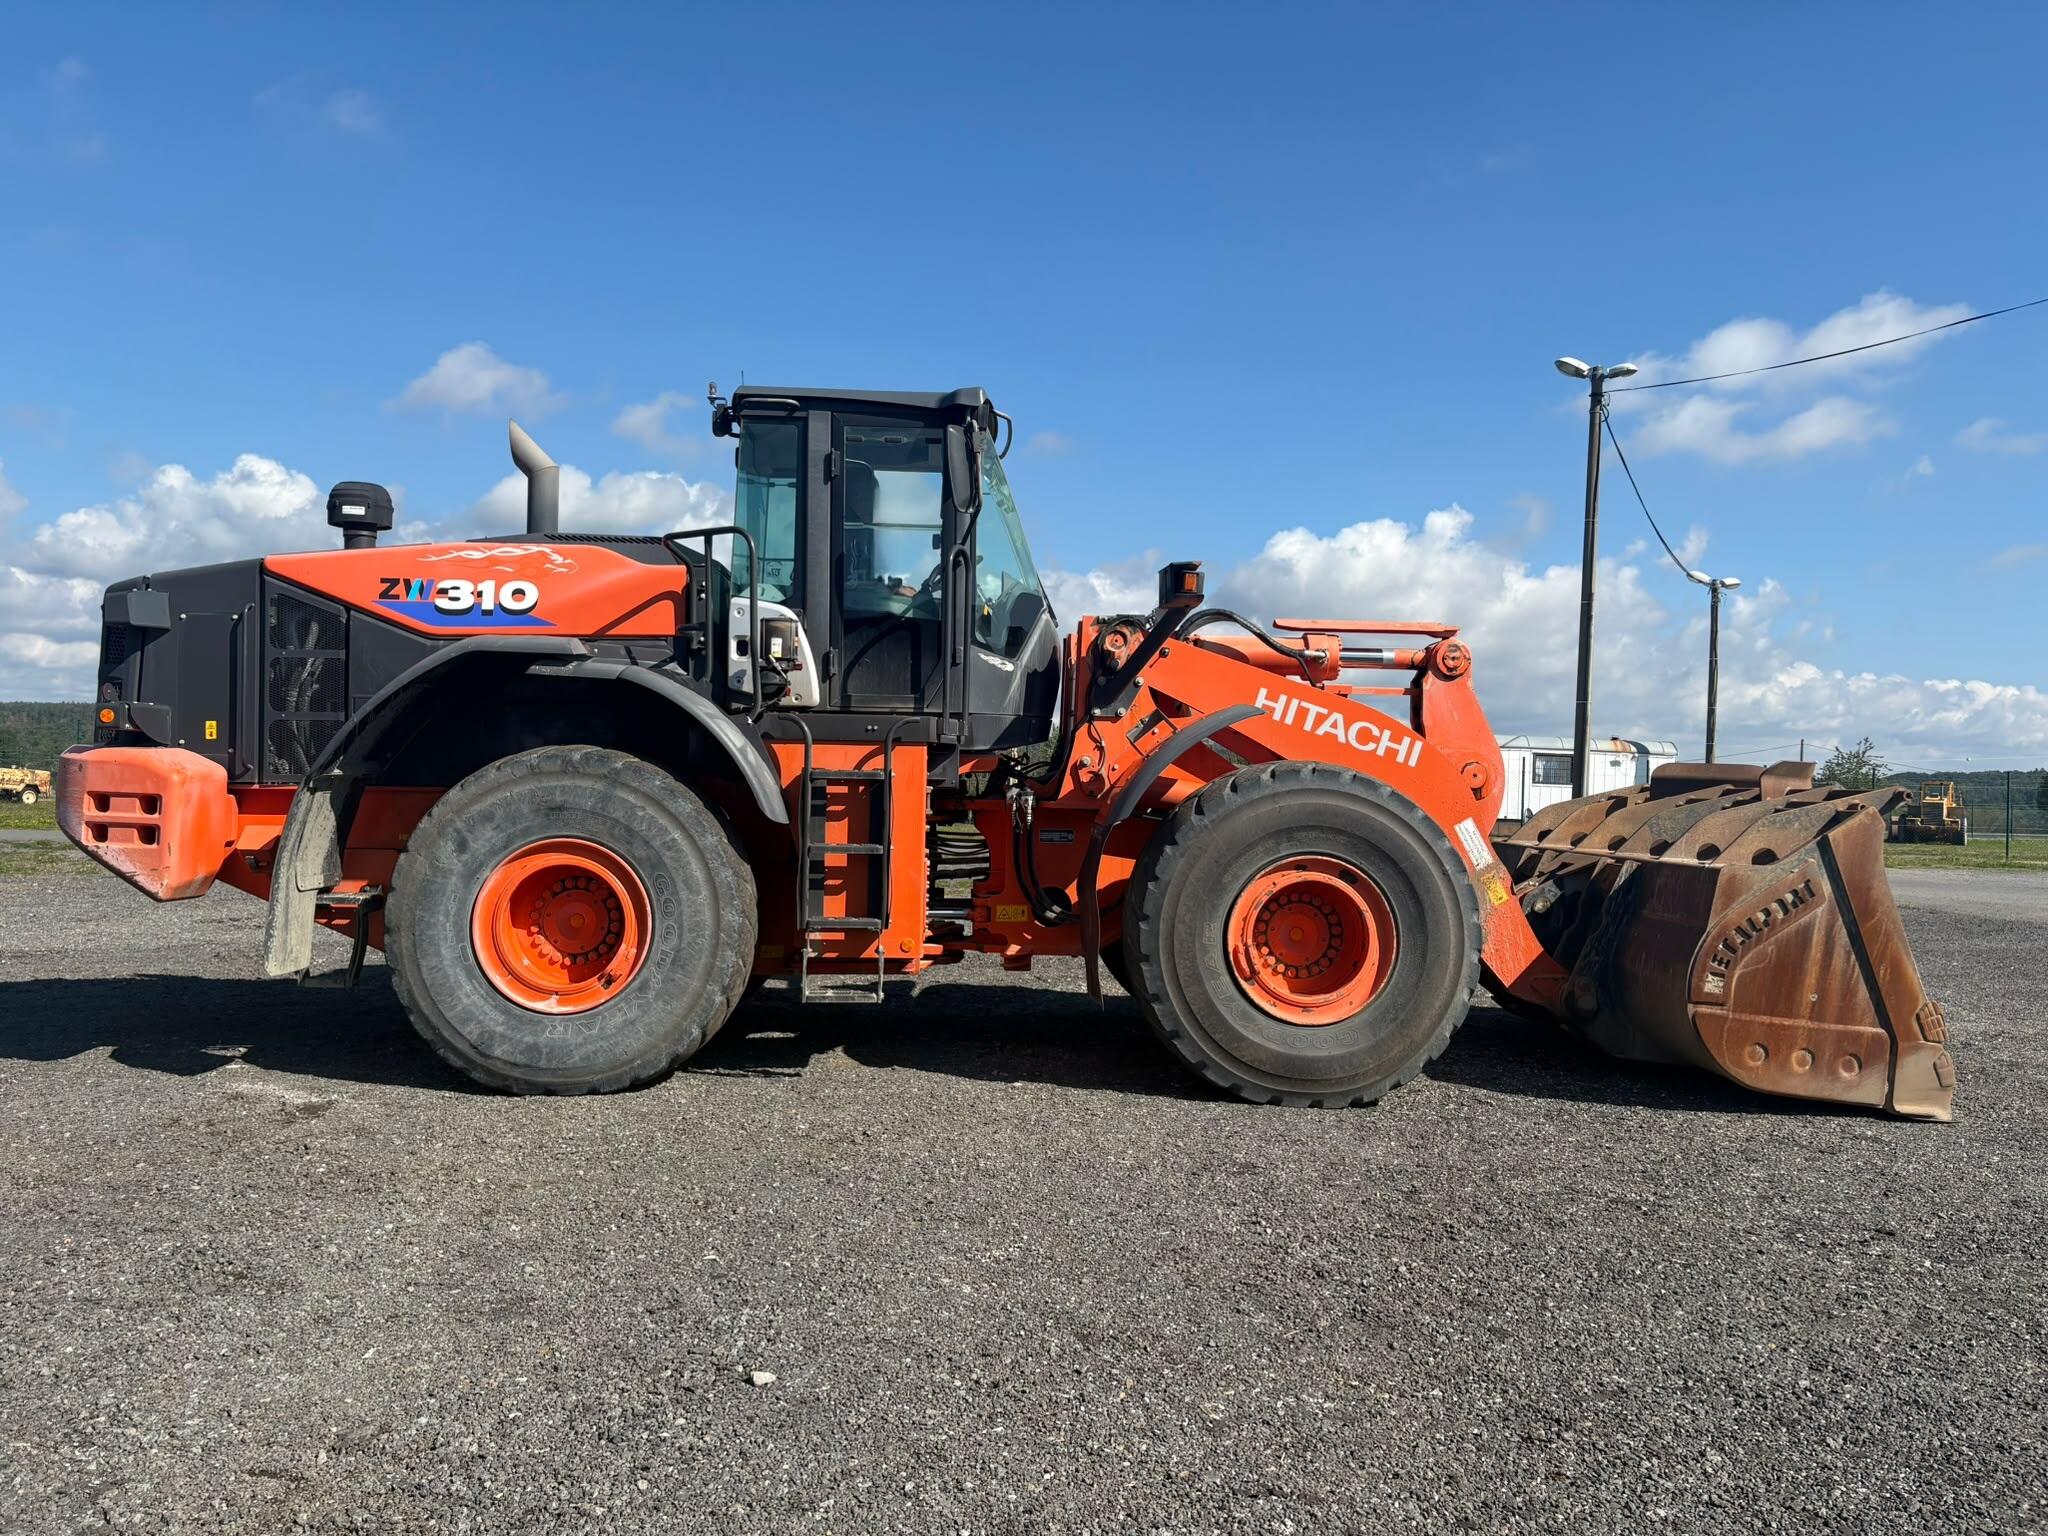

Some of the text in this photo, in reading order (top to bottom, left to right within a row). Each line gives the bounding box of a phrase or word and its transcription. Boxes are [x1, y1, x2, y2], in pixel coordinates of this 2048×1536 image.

[378, 577, 540, 616] ZW310
[1253, 687, 1424, 768] HITACHI
[1201, 921, 1360, 1049] GOODYEAR
[1703, 878, 1816, 994] METALPORT
